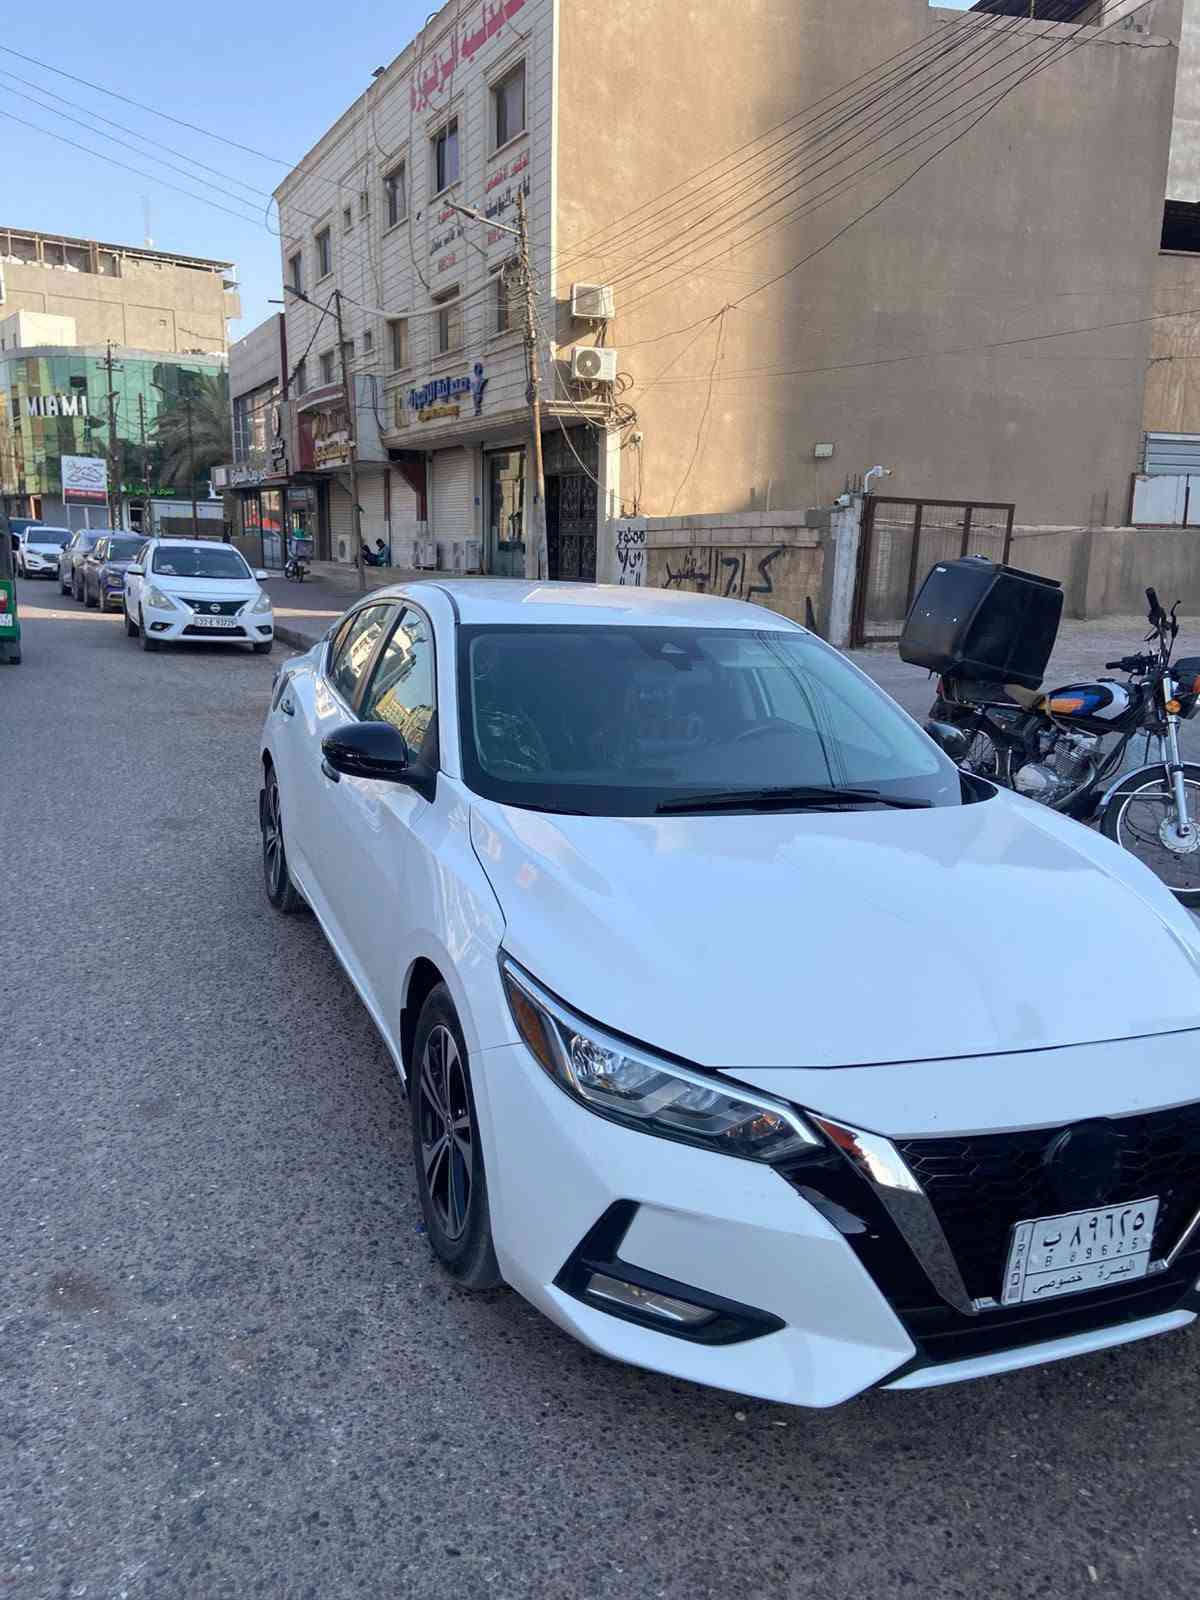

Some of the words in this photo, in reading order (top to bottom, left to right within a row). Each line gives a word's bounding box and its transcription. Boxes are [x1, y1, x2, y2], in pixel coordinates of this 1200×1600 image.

[27, 394, 88, 417] MIAMI
[1043, 1231, 1062, 1252] ب
[1069, 1209, 1145, 1248] ٨٩٦٢٥
[1032, 1271, 1083, 1294] خصوصي
